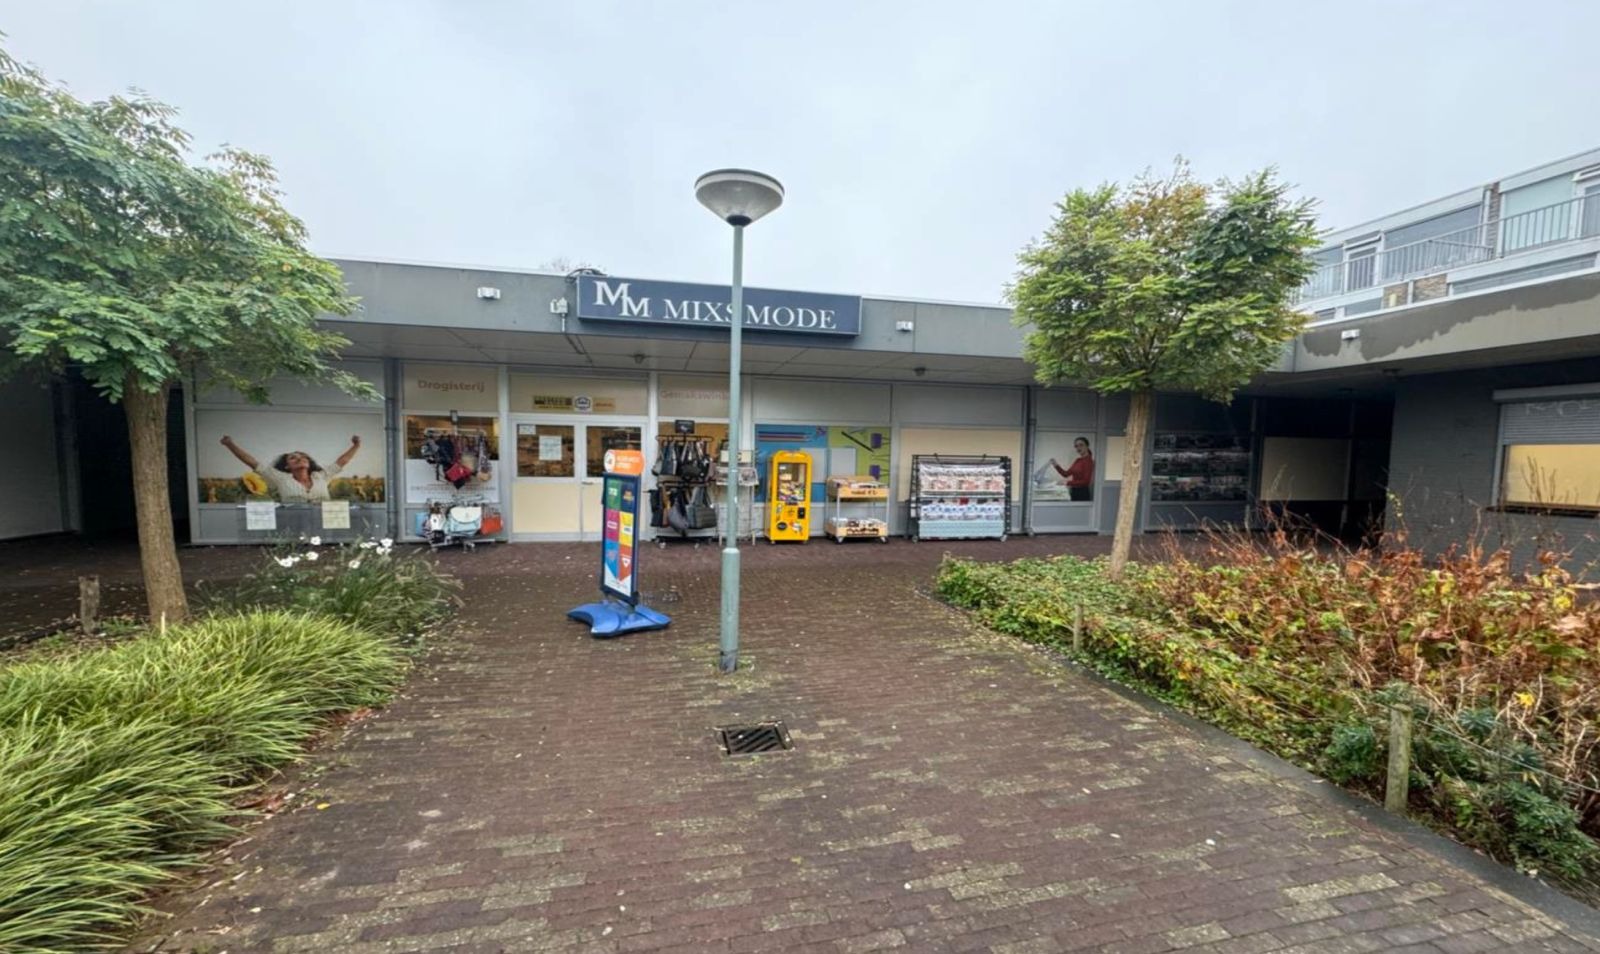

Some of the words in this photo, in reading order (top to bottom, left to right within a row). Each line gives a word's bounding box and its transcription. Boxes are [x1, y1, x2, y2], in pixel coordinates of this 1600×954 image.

[592, 280, 651, 318] MM
[745, 304, 837, 330] MODE
[417, 379, 485, 393] Drogisterij
